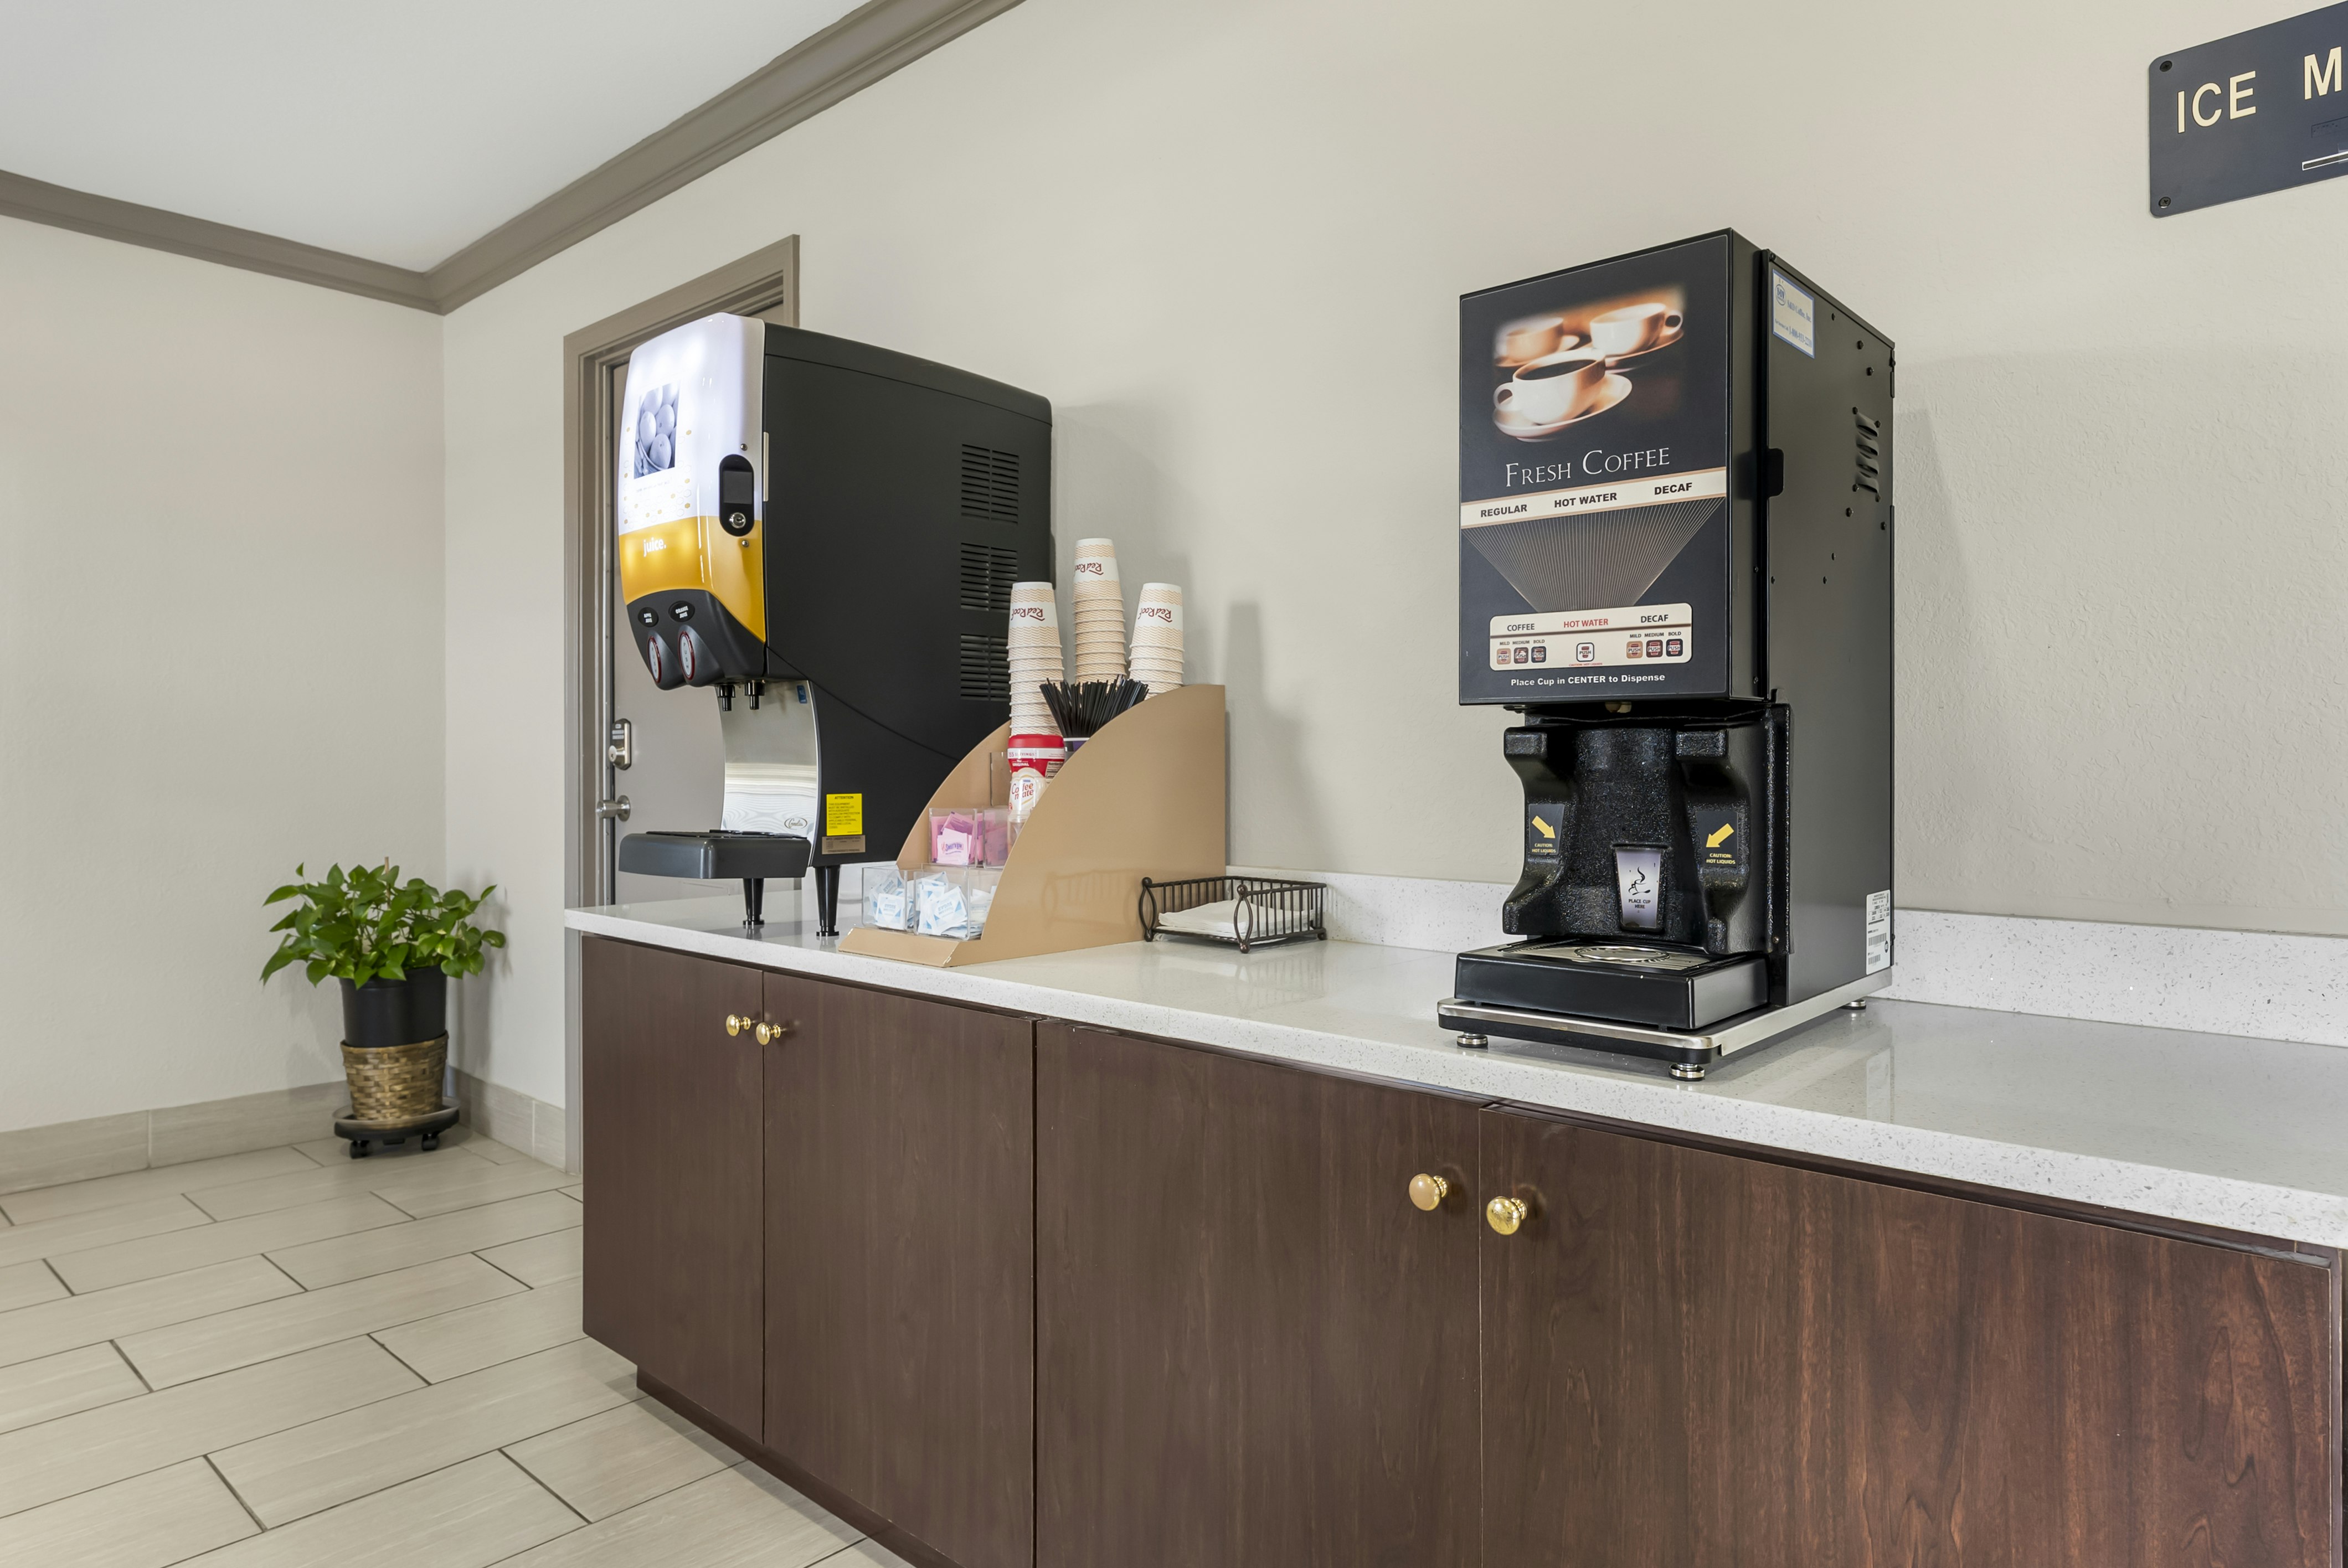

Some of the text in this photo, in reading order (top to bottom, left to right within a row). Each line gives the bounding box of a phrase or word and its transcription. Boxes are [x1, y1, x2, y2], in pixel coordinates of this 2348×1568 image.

[2177, 46, 2342, 133] ICE M
[1480, 482, 1693, 518] REGULAR HOT WATER DECAF
[1582, 618, 1609, 627] WATER
[1641, 615, 1669, 623] DECAF
[1537, 678, 1554, 686] Cup
[1568, 676, 1606, 684] CENTER
[1621, 674, 1665, 683] Dispense
[1012, 783, 1033, 795] Cofee
